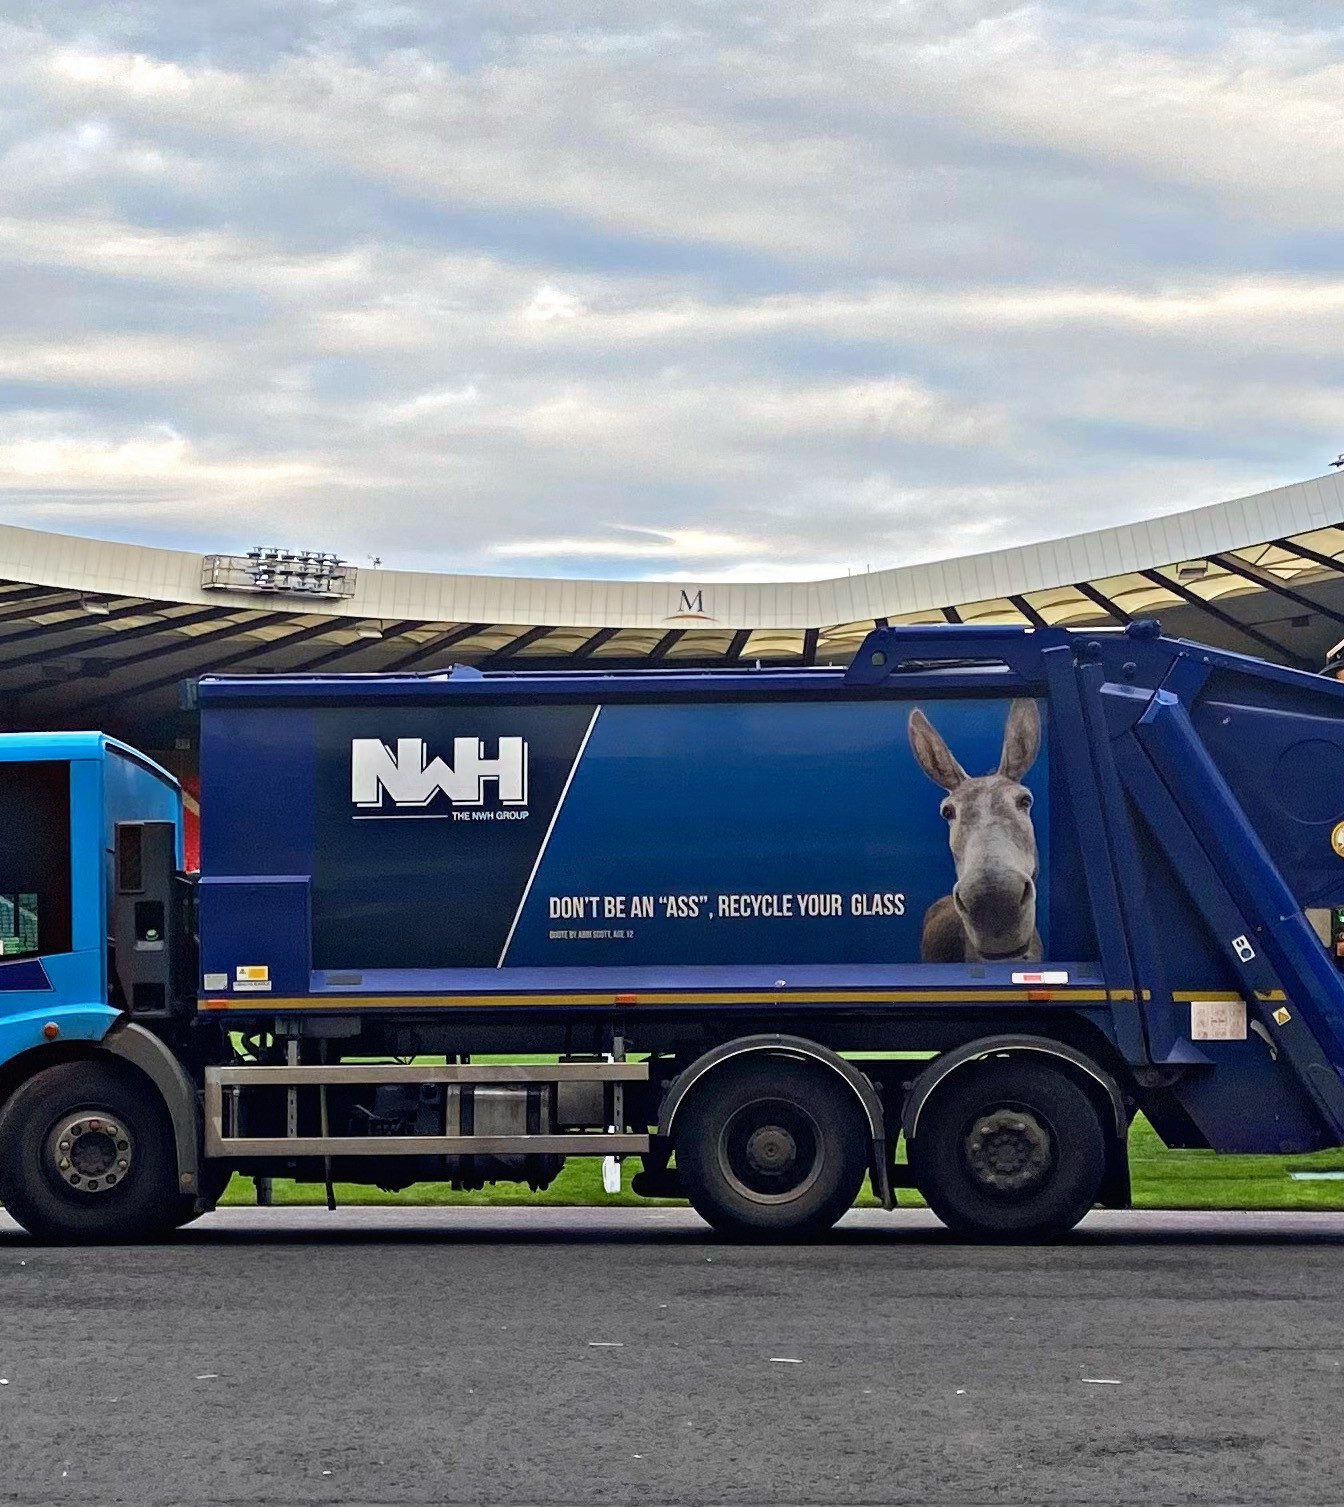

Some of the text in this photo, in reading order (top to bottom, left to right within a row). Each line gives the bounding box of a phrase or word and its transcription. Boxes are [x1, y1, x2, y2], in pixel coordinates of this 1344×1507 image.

[677, 590, 704, 612] M
[352, 737, 528, 807] NWH
[452, 810, 529, 820] THE NWH GROUP
[549, 896, 600, 918] DON'T
[604, 896, 626, 918] BE
[630, 896, 654, 918] AN
[718, 895, 793, 917] RECYCLE
[797, 894, 843, 916] YOUR
[851, 894, 905, 916] GLASS
[626, 930, 634, 938] 12
